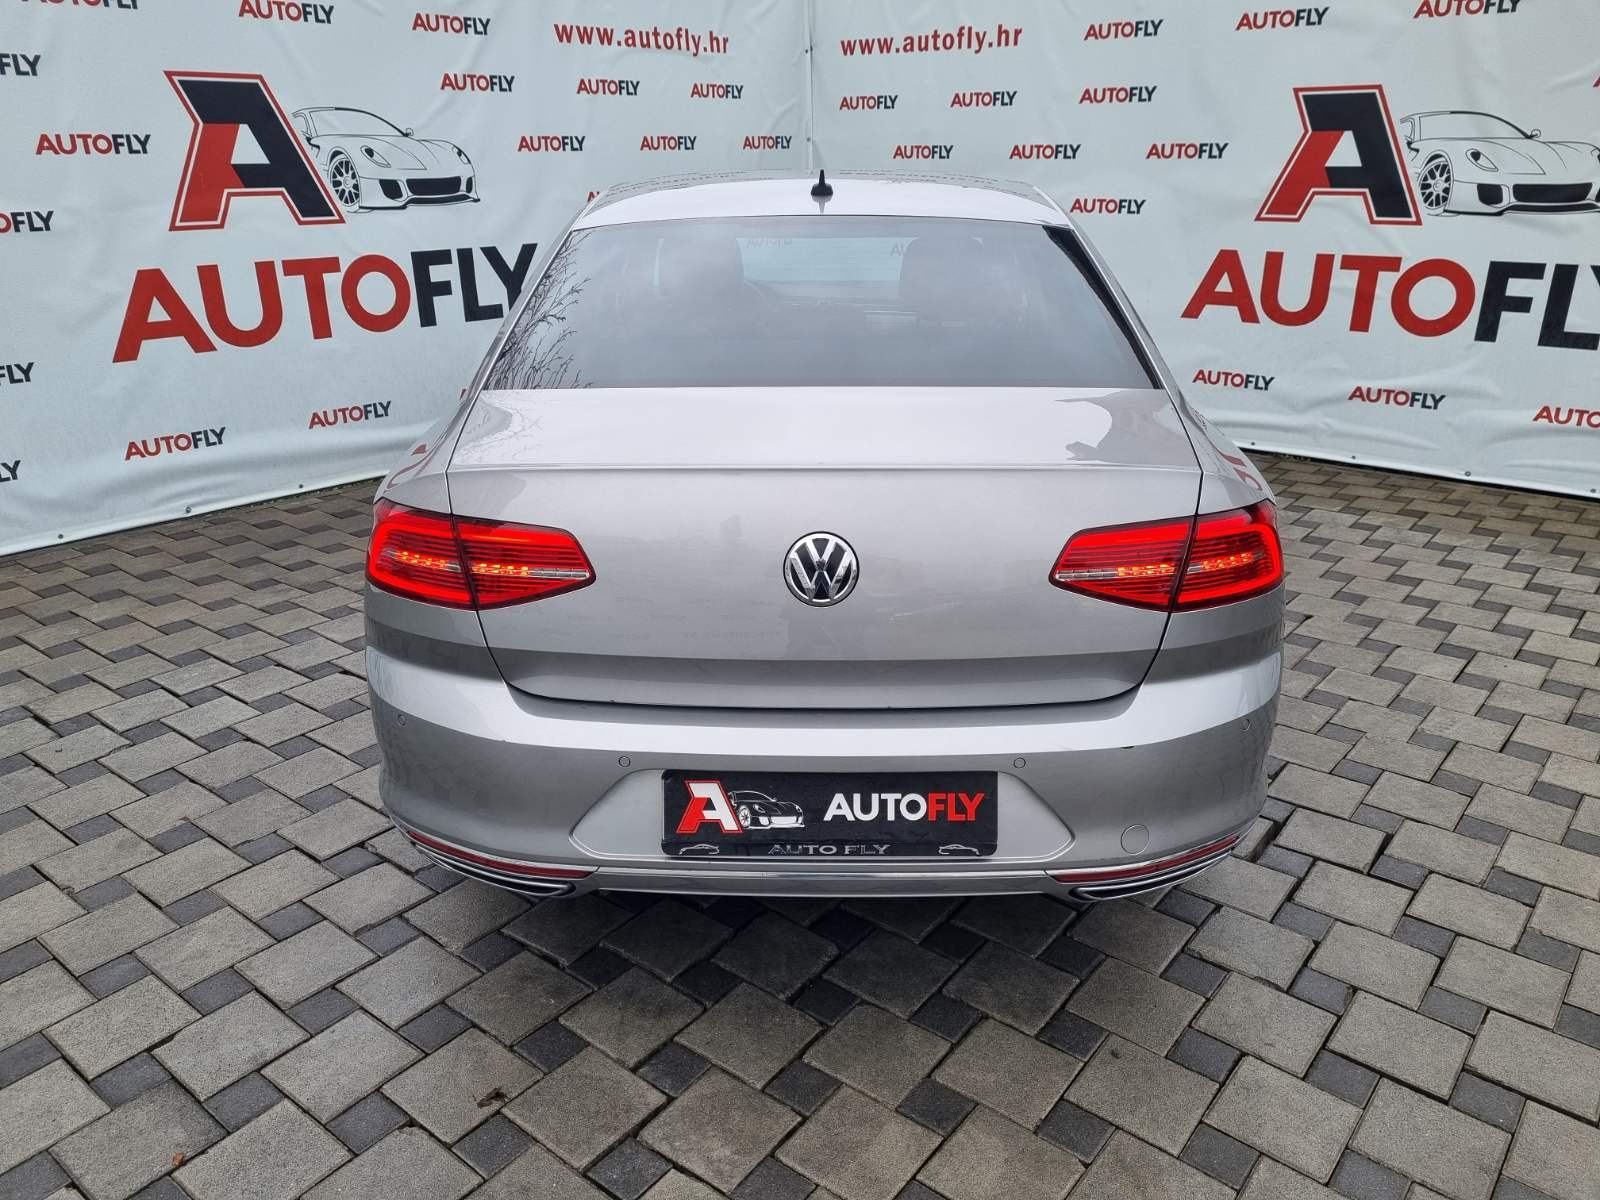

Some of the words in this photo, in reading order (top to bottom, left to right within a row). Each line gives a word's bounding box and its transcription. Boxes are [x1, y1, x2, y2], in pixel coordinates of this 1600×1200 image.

[238, 0, 334, 24] AUTOFLY
[1413, 0, 1520, 18] AUTOFLY
[411, 13, 491, 36] AUTOFLY
[1235, 7, 1330, 31] AUTOFLY
[1084, 19, 1164, 41] AUTOFLY
[553, 23, 729, 57] www.autofly.hr
[840, 24, 1023, 57] www.autofly.hr
[440, 73, 515, 92] AUTOFLY
[576, 78, 640, 96] AUTOFLY
[690, 83, 744, 100] AUTOFLY
[839, 94, 898, 111] AUTOFLY
[950, 91, 1018, 108] AUTOFLY
[1079, 86, 1158, 104] AUTOFLY
[36, 134, 151, 155] AUTOFLY
[518, 135, 586, 152] AUTOFLY
[640, 135, 697, 151] AUTOFLY
[743, 135, 793, 150] AUTOFLY
[892, 144, 954, 160] AUTOFLY
[1009, 144, 1082, 160] AUTOFLY
[1146, 142, 1229, 160] AUTOFLY
[1070, 198, 1146, 215] AUTOFLY
[112, 243, 538, 363] AUTOFLY
[1180, 249, 1600, 351] AUTOFL
[1193, 369, 1275, 391] AUTOFLY
[1348, 386, 1446, 410] AUTOFLY
[308, 401, 392, 430] AUTOFLY
[124, 427, 226, 461] AUTOFLY
[823, 793, 986, 822] AUTOFLY
[768, 844, 838, 855] AUTO
[844, 844, 891, 855] FLY
